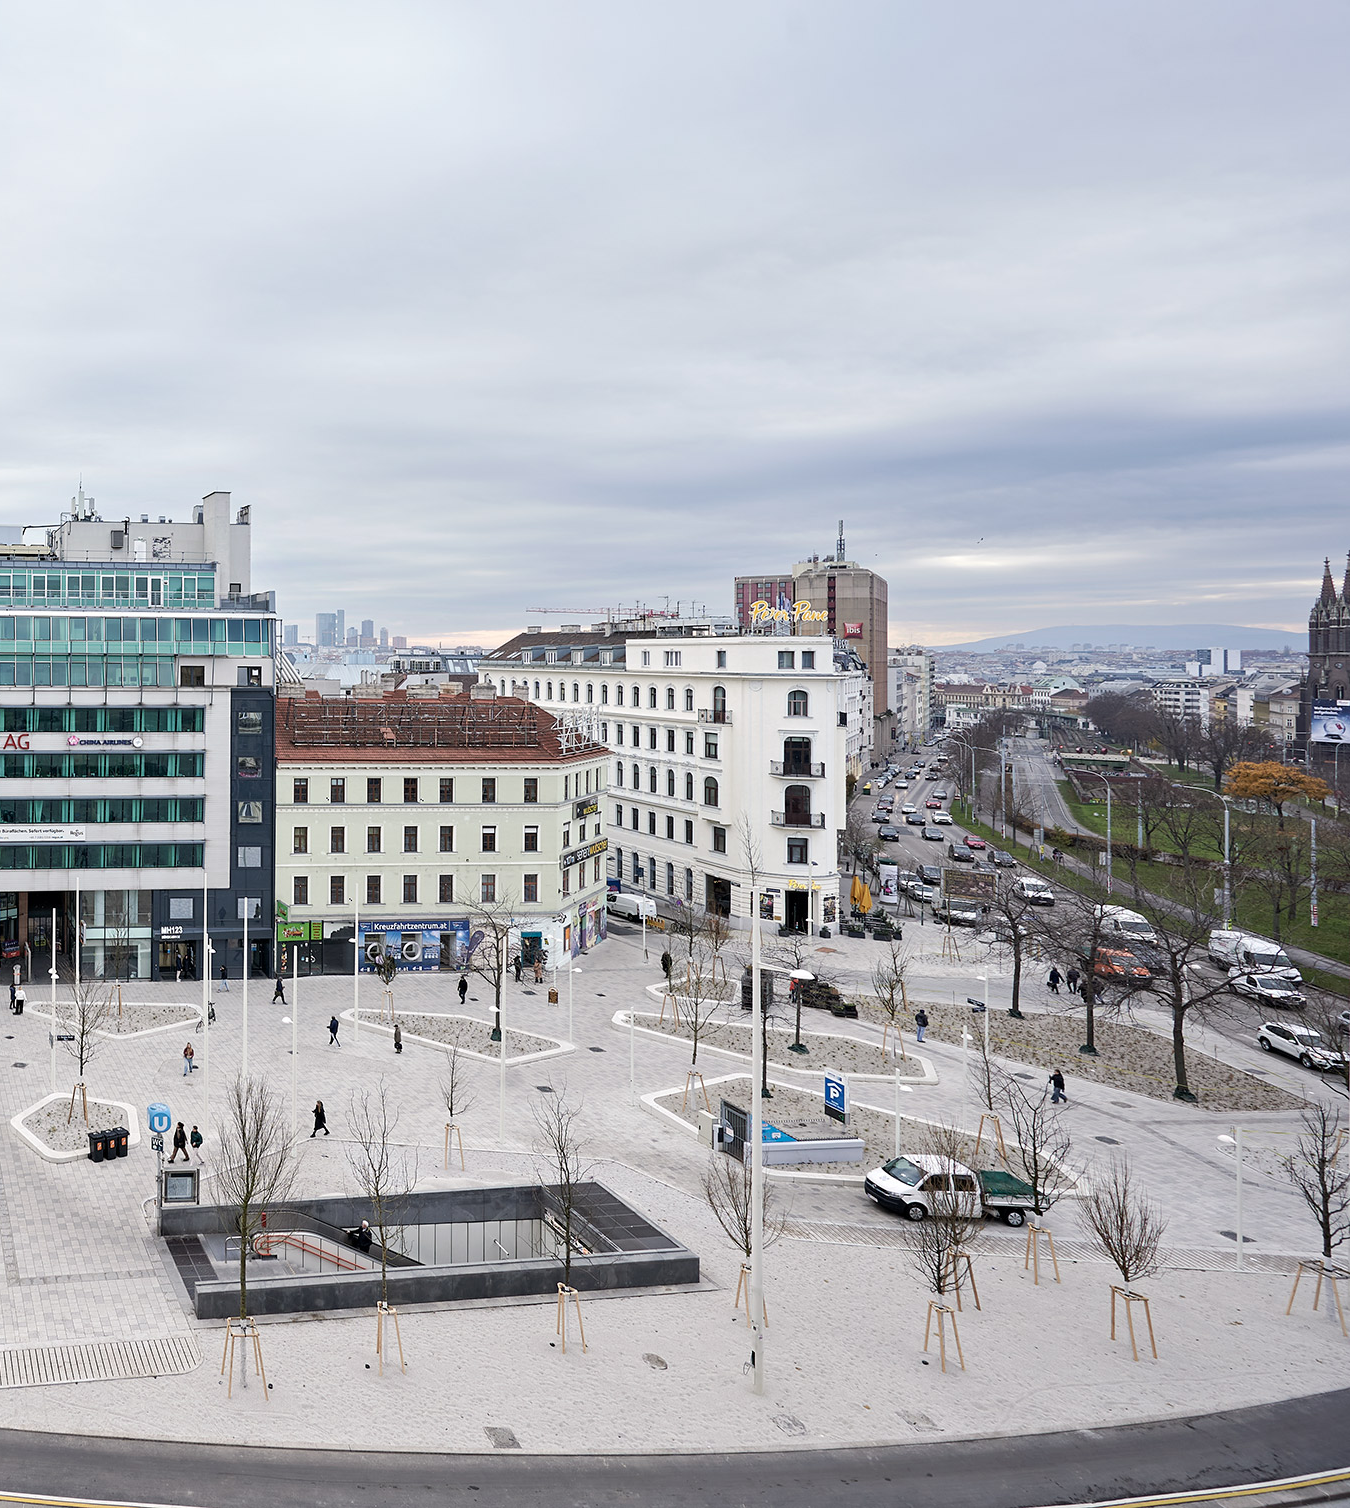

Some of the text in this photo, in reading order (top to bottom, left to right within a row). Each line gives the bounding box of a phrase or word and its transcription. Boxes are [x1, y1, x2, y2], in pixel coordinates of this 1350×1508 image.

[748, 600, 828, 622] Peter Pane
[847, 626, 861, 634] ibis
[3, 733, 30, 750] AG
[161, 926, 183, 934] MH123
[374, 922, 447, 931] Kreuzfahrtzentrum.at
[152, 1138, 163, 1147] WC
